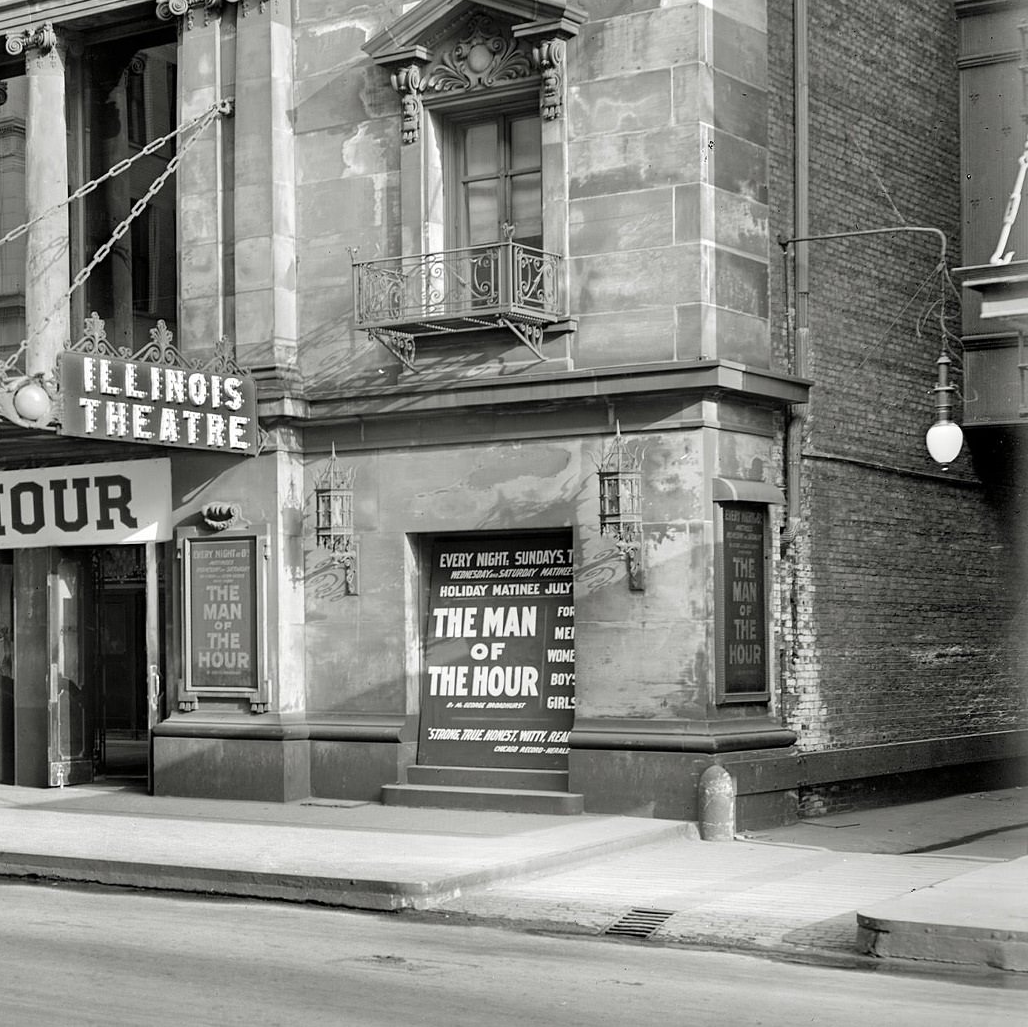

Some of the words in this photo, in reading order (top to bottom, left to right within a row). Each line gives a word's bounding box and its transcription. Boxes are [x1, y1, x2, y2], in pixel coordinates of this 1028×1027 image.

[83, 356, 245, 411] ILLINOIS
[79, 397, 251, 450] THEATRE
[439, 552, 475, 568] EVERY
[732, 556, 756, 579] THE
[498, 568, 539, 578] SATURDAY
[205, 584, 240, 602] THE
[439, 584, 489, 598] HOLIDAY
[492, 583, 540, 596] MATINEE
[544, 582, 573, 595] JULY
[732, 580, 758, 603] MAN
[203, 603, 243, 621] MAN
[739, 604, 753, 617] OF
[214, 621, 233, 631] OF
[433, 606, 478, 638] THE
[481, 605, 538, 638] MAN
[733, 618, 757, 641] THE
[206, 632, 241, 649] THE
[554, 626, 575, 640] ME
[197, 651, 251, 669] HOUR
[470, 642, 506, 661] OF
[728, 643, 762, 666] HOUR
[428, 665, 470, 697] THE
[471, 665, 540, 697] HOUR
[546, 696, 576, 710] GIRLS
[493, 745, 520, 753] CHICAGO
